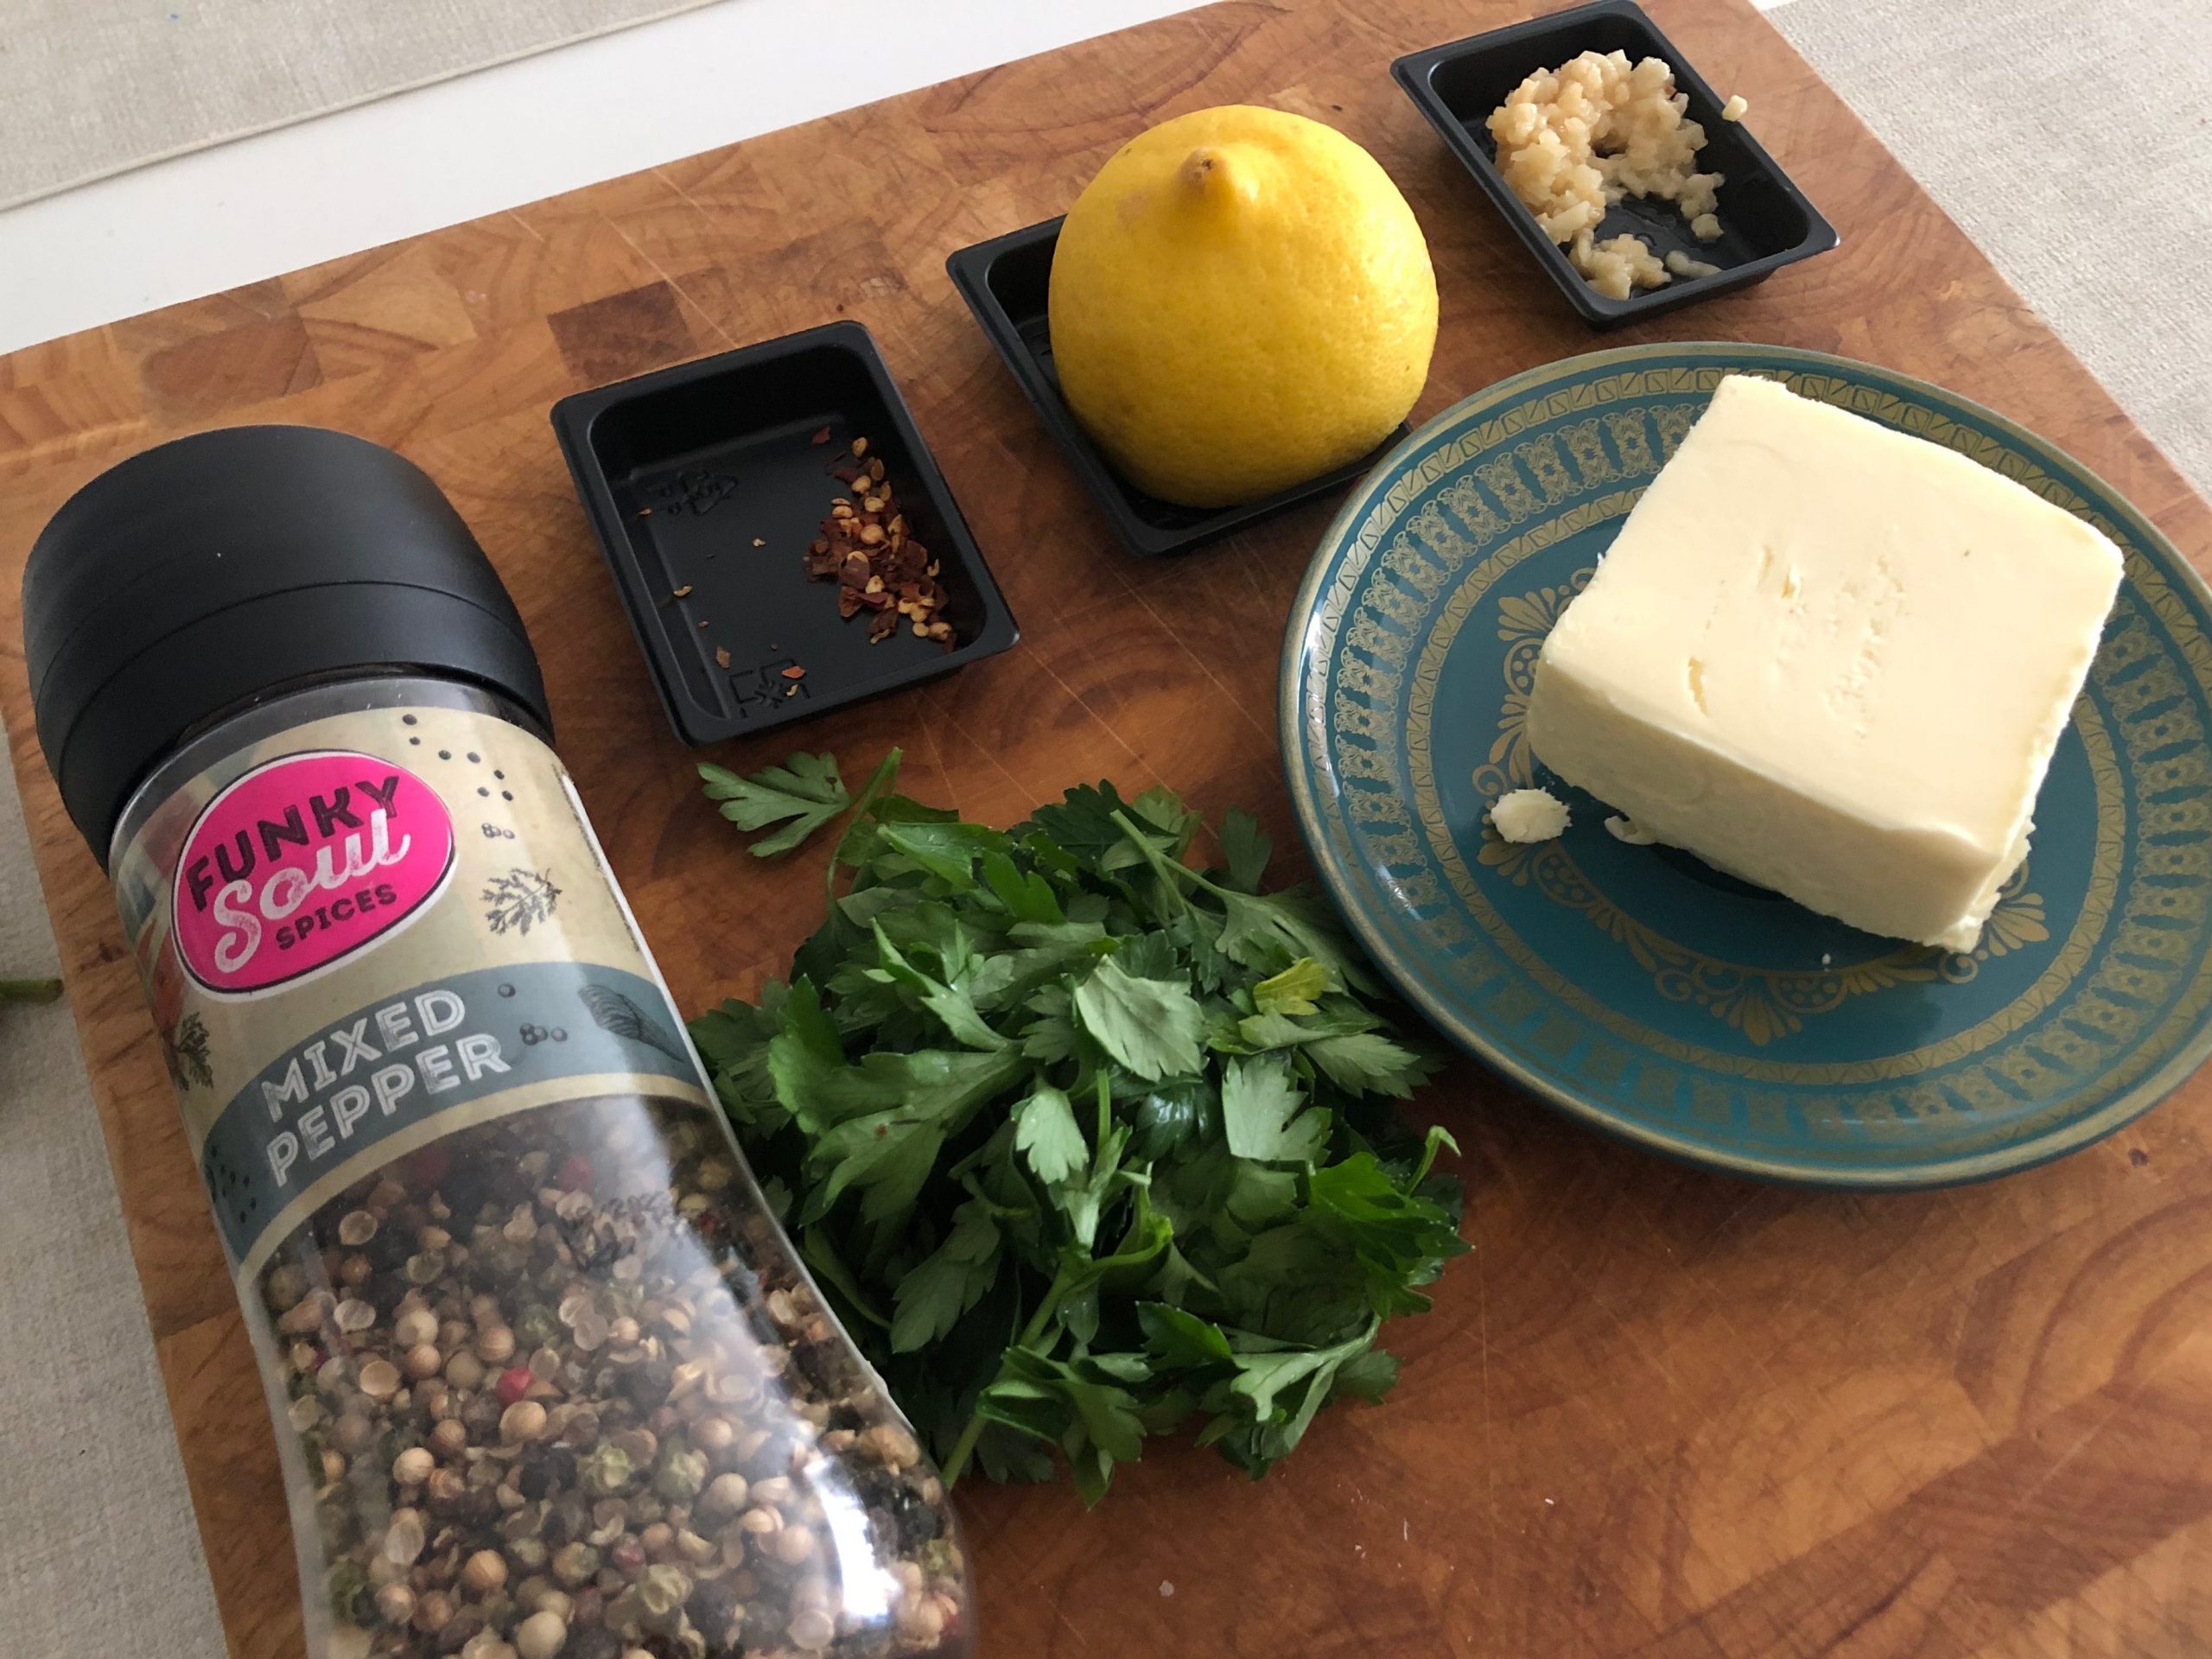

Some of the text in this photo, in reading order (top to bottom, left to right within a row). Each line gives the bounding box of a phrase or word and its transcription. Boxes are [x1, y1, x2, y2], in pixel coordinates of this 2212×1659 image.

[186, 775, 401, 912] FUNKY
[213, 809, 412, 974] Soul
[276, 883, 397, 950] SPICES
[261, 989, 466, 1122] MIXED
[267, 1033, 512, 1187] PEPPER
